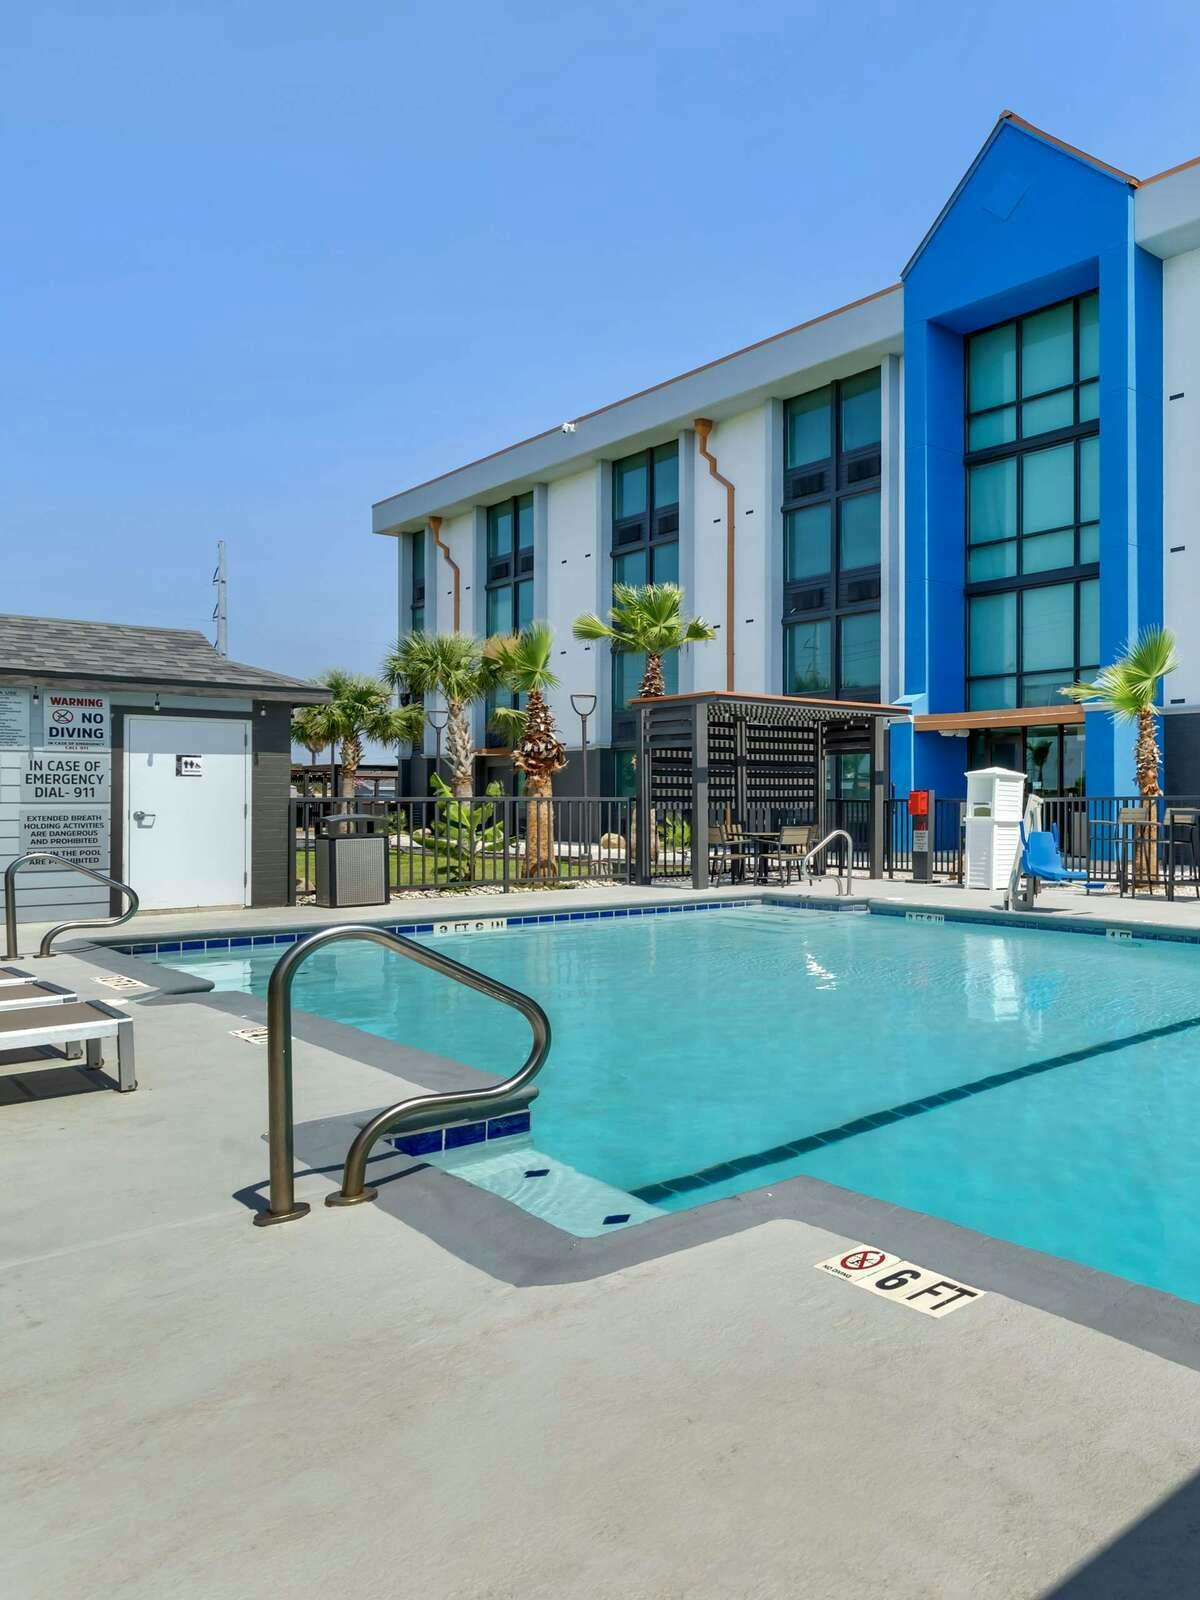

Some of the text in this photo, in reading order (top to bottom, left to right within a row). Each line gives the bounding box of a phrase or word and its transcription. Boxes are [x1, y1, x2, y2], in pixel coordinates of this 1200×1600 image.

[50, 696, 103, 708] WARNING
[81, 712, 104, 724] NO
[48, 726, 104, 739] DIVING
[29, 759, 101, 772] IN CASE OF
[25, 773, 104, 785] EMERGENCY
[35, 787, 95, 798] DIAL- 911
[875, 1269, 978, 1311] 6 FT
